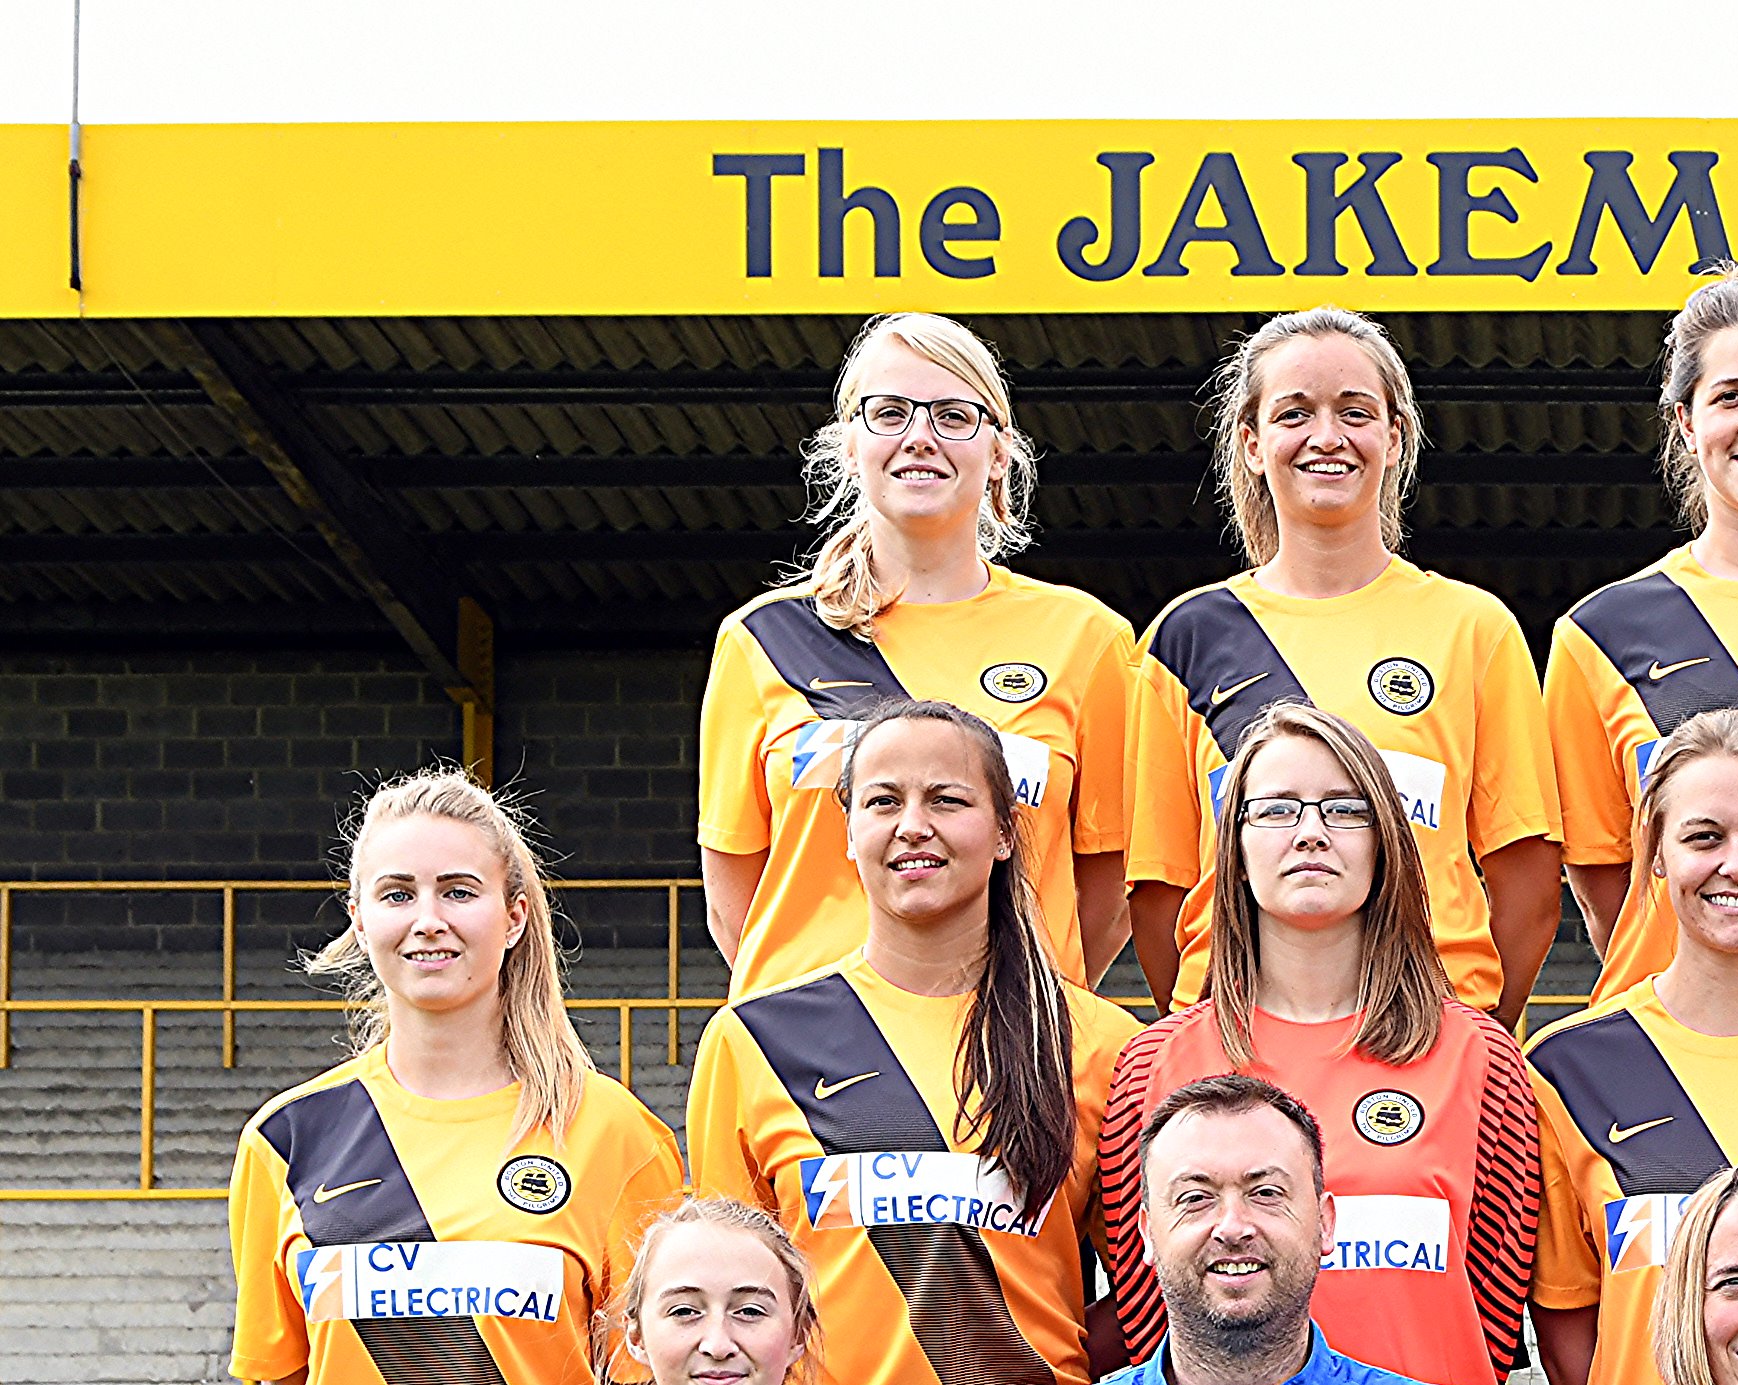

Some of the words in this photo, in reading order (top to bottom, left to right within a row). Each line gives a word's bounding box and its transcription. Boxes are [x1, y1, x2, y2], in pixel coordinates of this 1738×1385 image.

[712, 148, 1001, 276] The
[872, 1153, 923, 1179] CV
[873, 1193, 1038, 1237] ELECTRICAL
[368, 1243, 421, 1272] CV
[371, 1287, 557, 1322] ELECTRICAL
